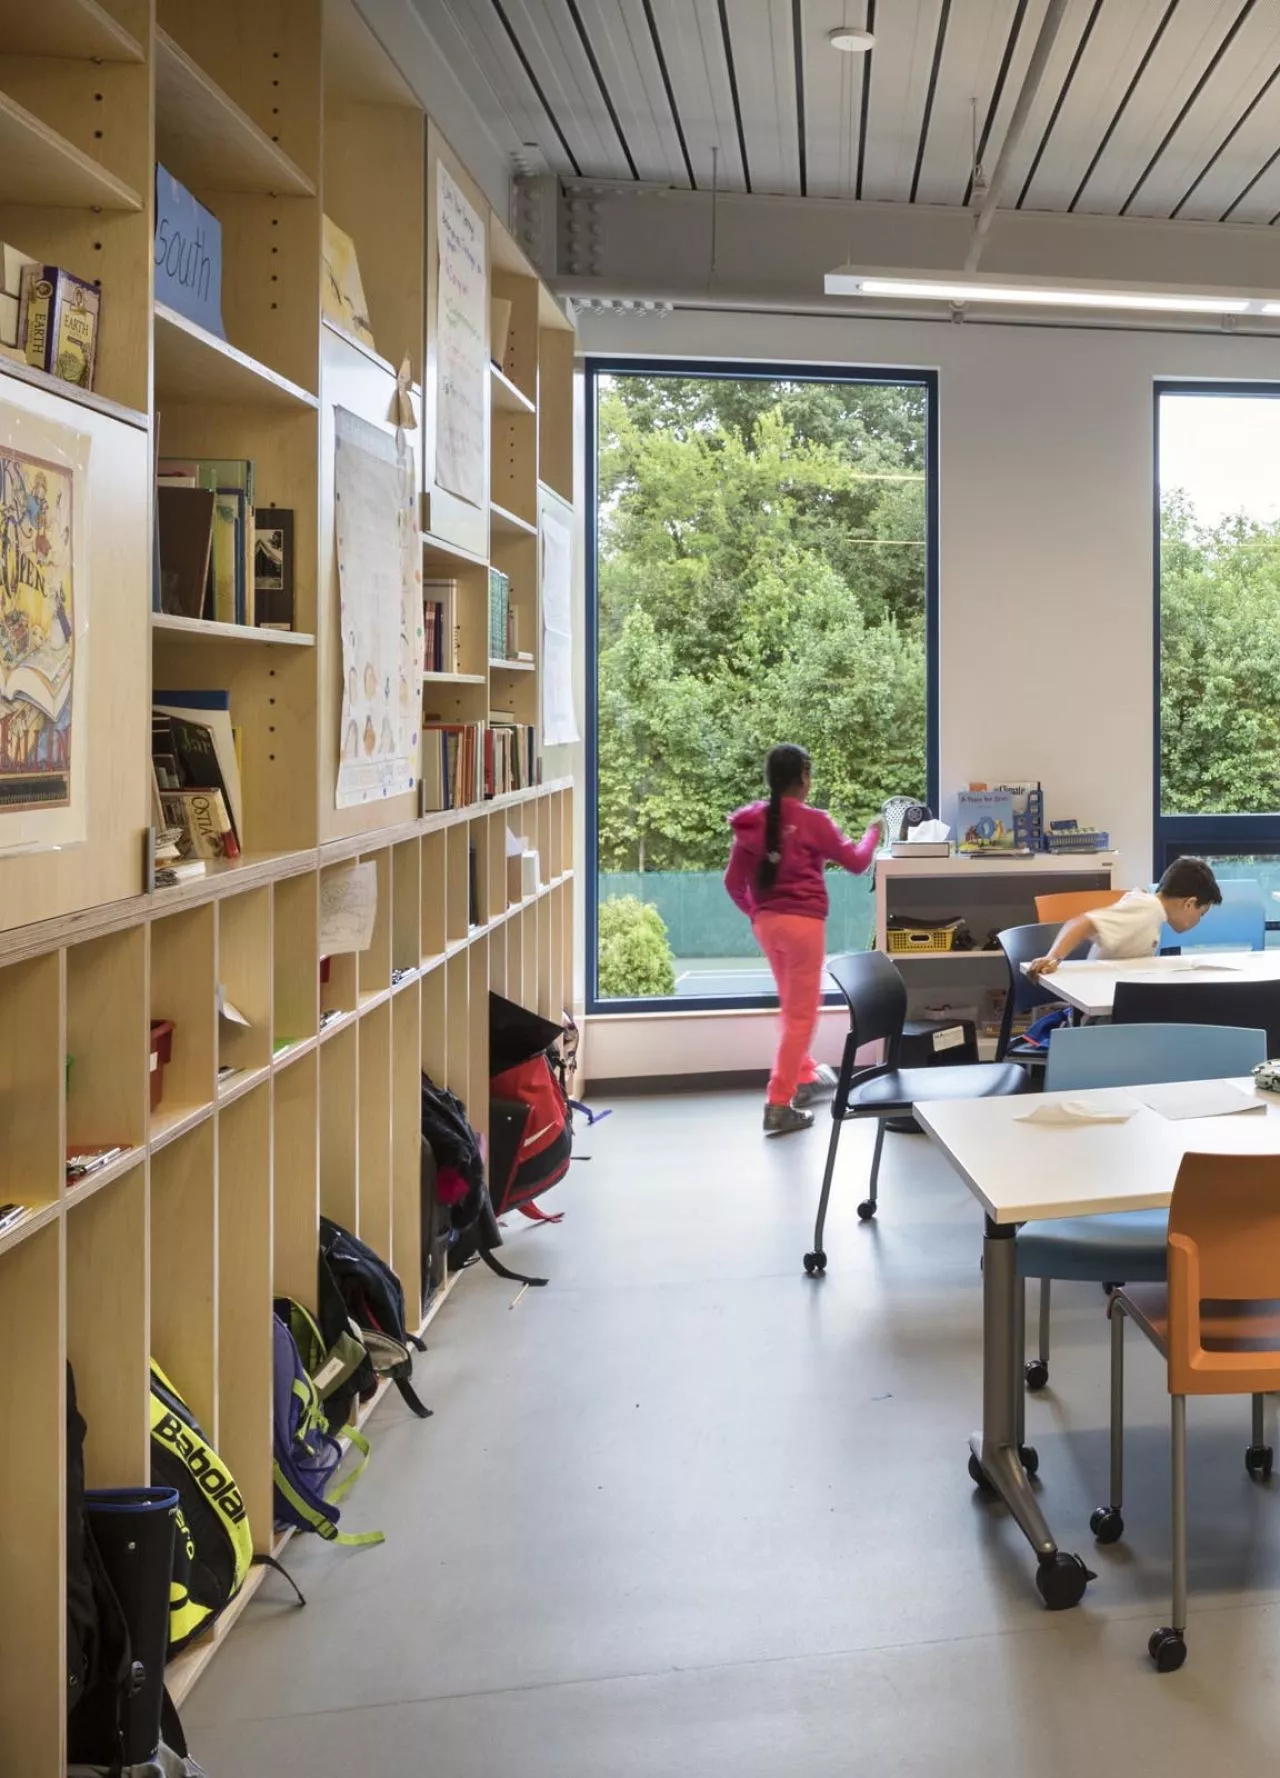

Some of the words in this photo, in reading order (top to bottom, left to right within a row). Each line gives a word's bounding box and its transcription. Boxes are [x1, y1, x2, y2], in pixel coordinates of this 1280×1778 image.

[33, 312, 46, 354] EARTH
[64, 313, 90, 336] EARTH
[190, 796, 214, 836] OSTIA
